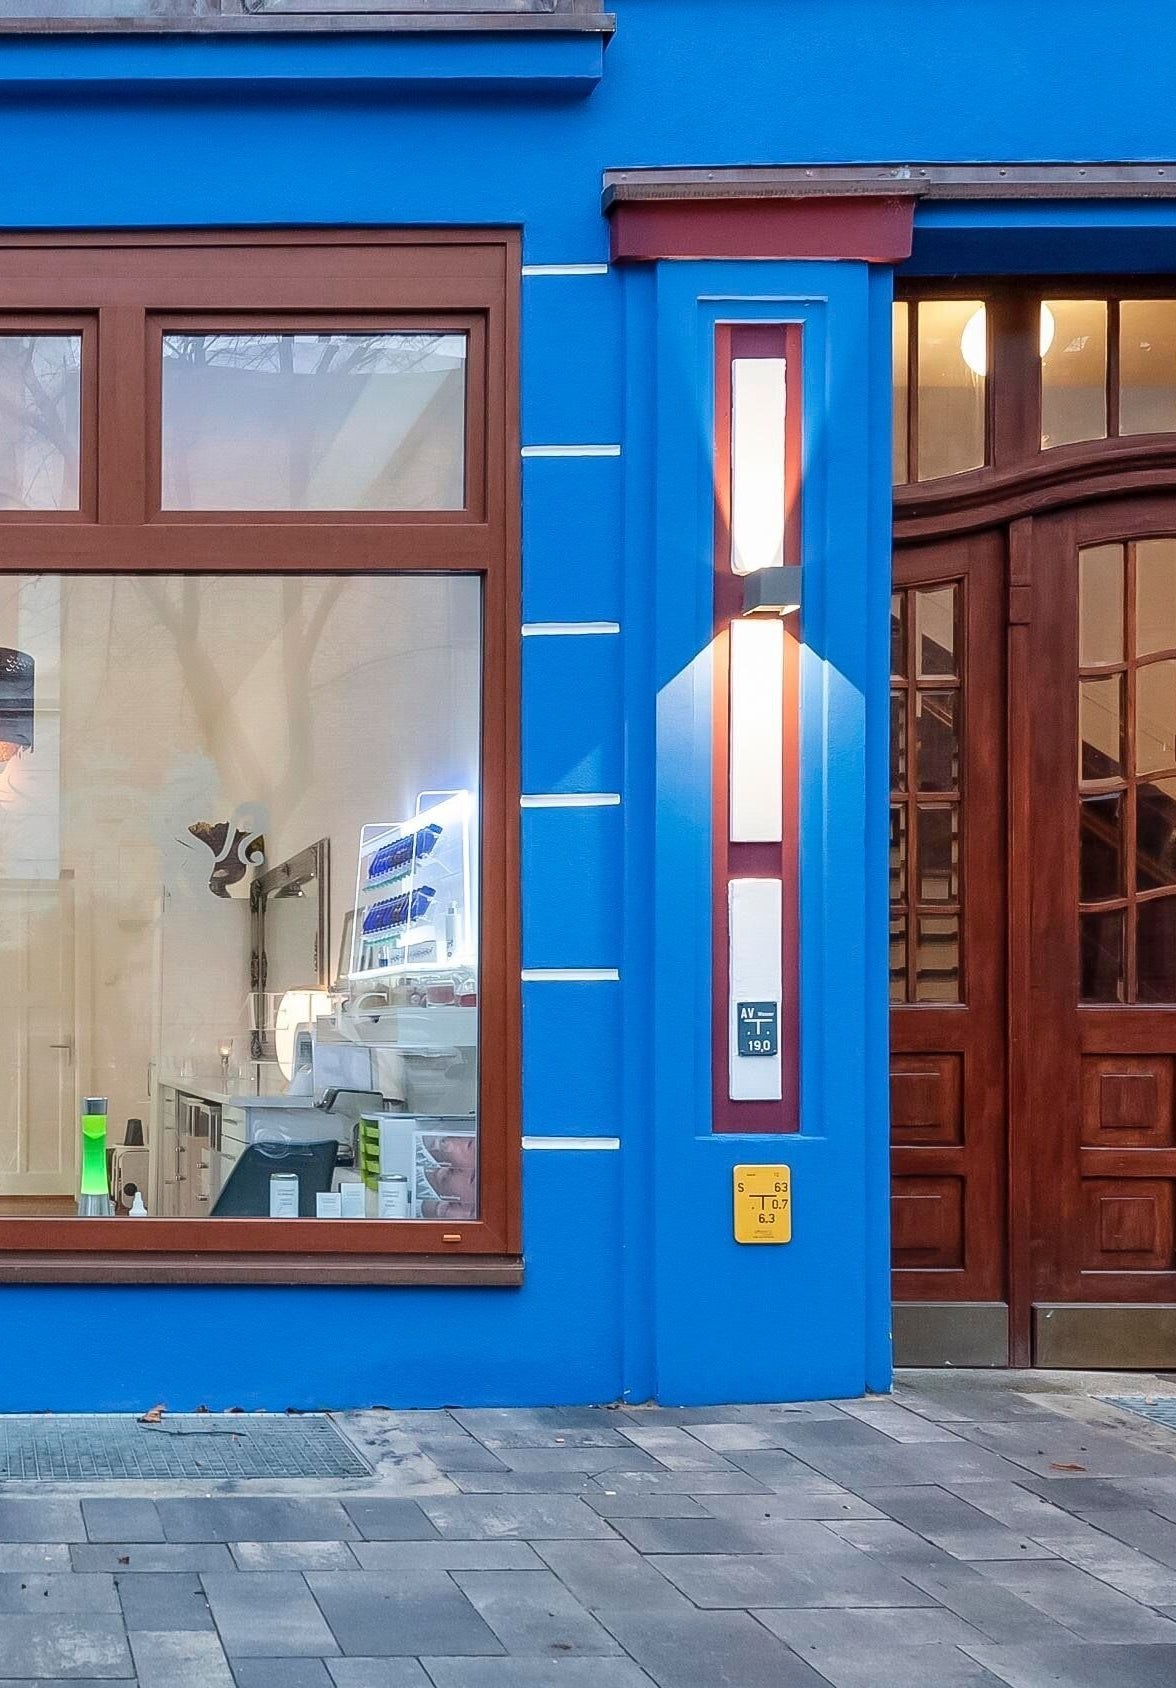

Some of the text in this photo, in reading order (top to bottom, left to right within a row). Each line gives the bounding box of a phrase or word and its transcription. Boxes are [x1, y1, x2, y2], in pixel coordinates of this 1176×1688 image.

[740, 1007, 755, 1019] AV
[737, 1182, 788, 1193] S 63
[772, 1199, 789, 1210] 0.7
[758, 1213, 776, 1224] 6.3
